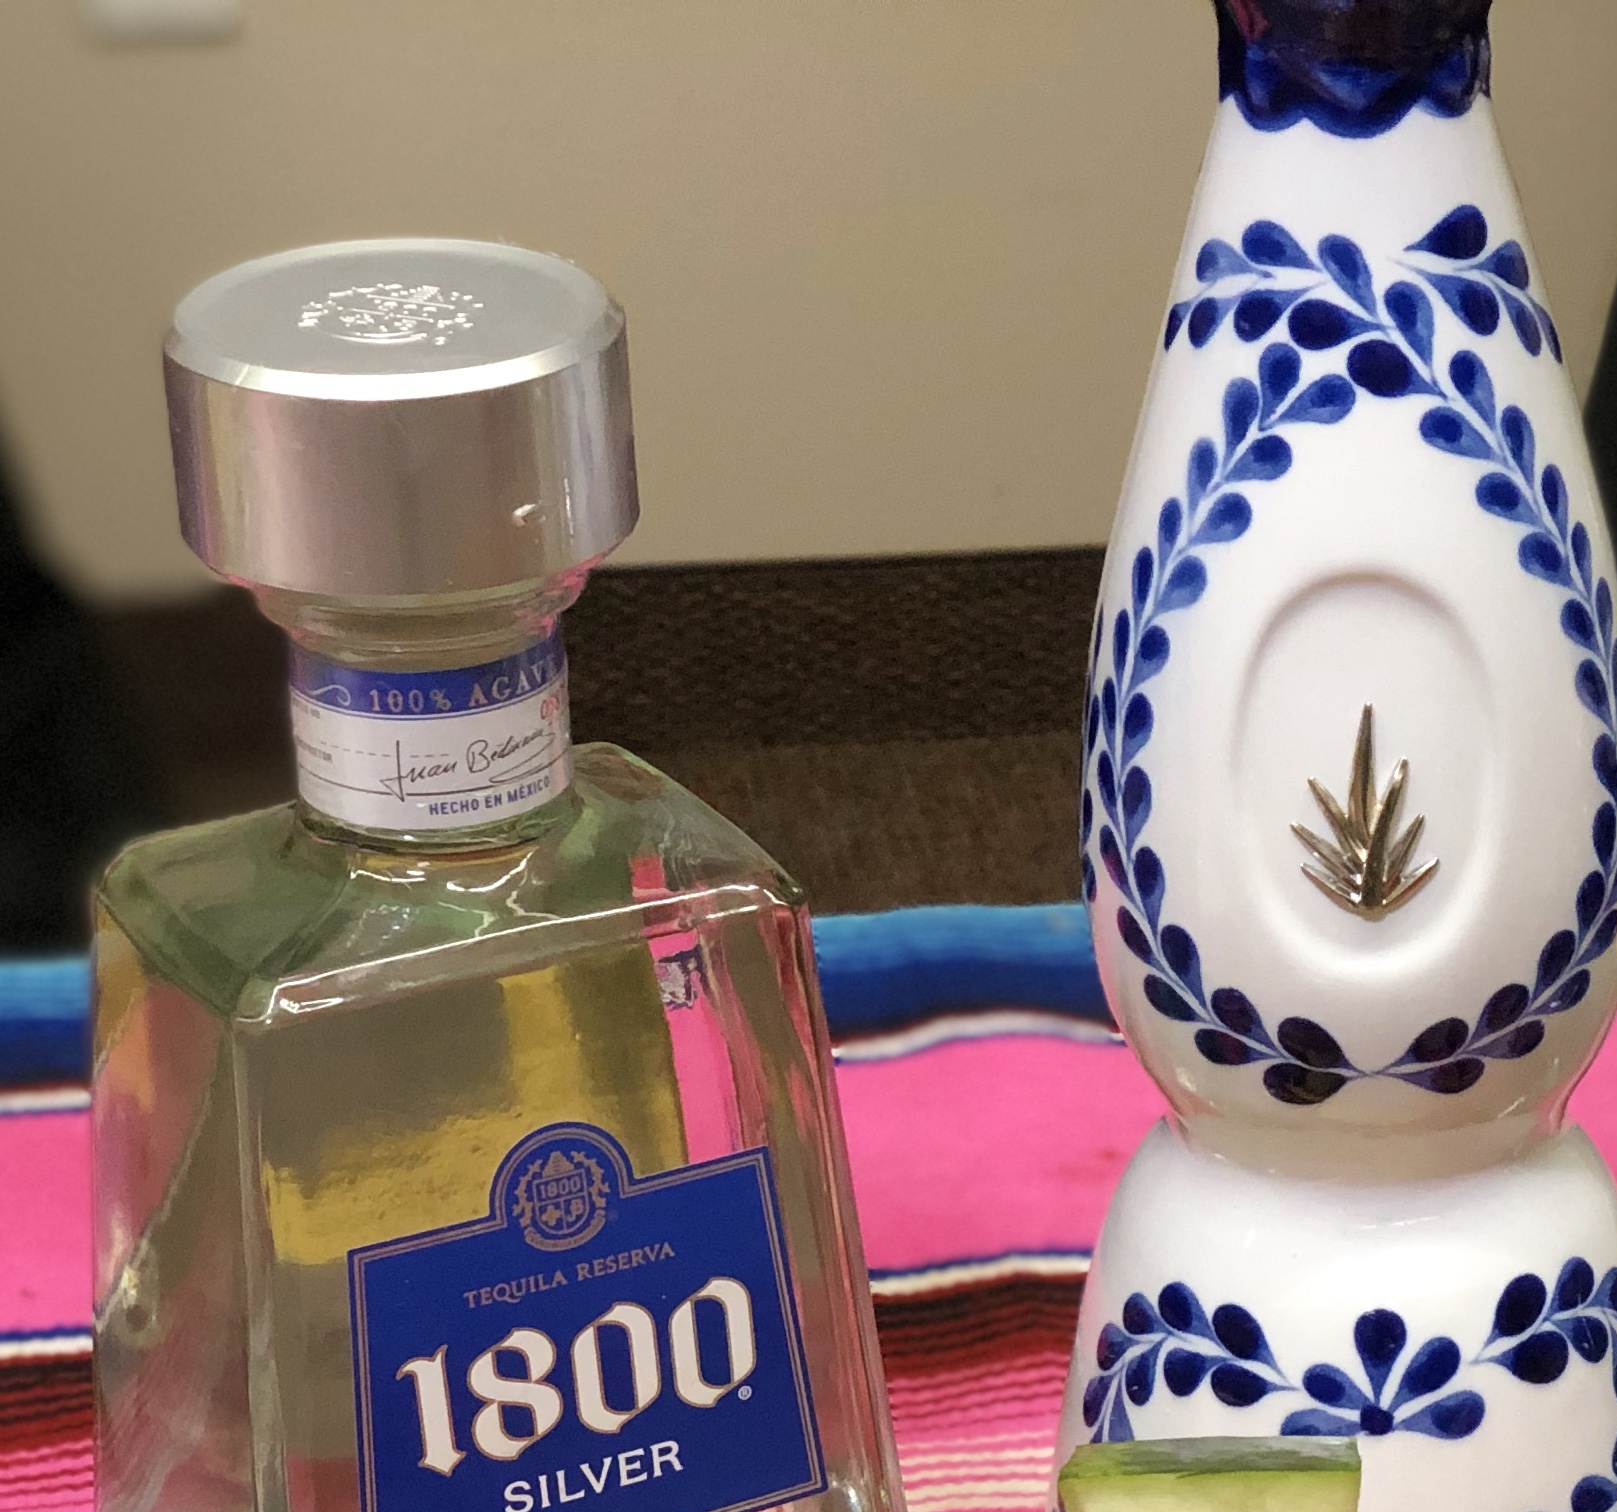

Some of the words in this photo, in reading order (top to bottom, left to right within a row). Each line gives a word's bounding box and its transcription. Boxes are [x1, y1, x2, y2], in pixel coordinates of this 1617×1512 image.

[368, 688, 452, 712] 100%
[429, 795, 480, 816] HECHO
[485, 792, 503, 809] EN
[539, 1177, 581, 1200] 1800
[464, 1268, 568, 1309] TEQUILA
[575, 1240, 676, 1282] RESERVA
[396, 1276, 757, 1476] 1800
